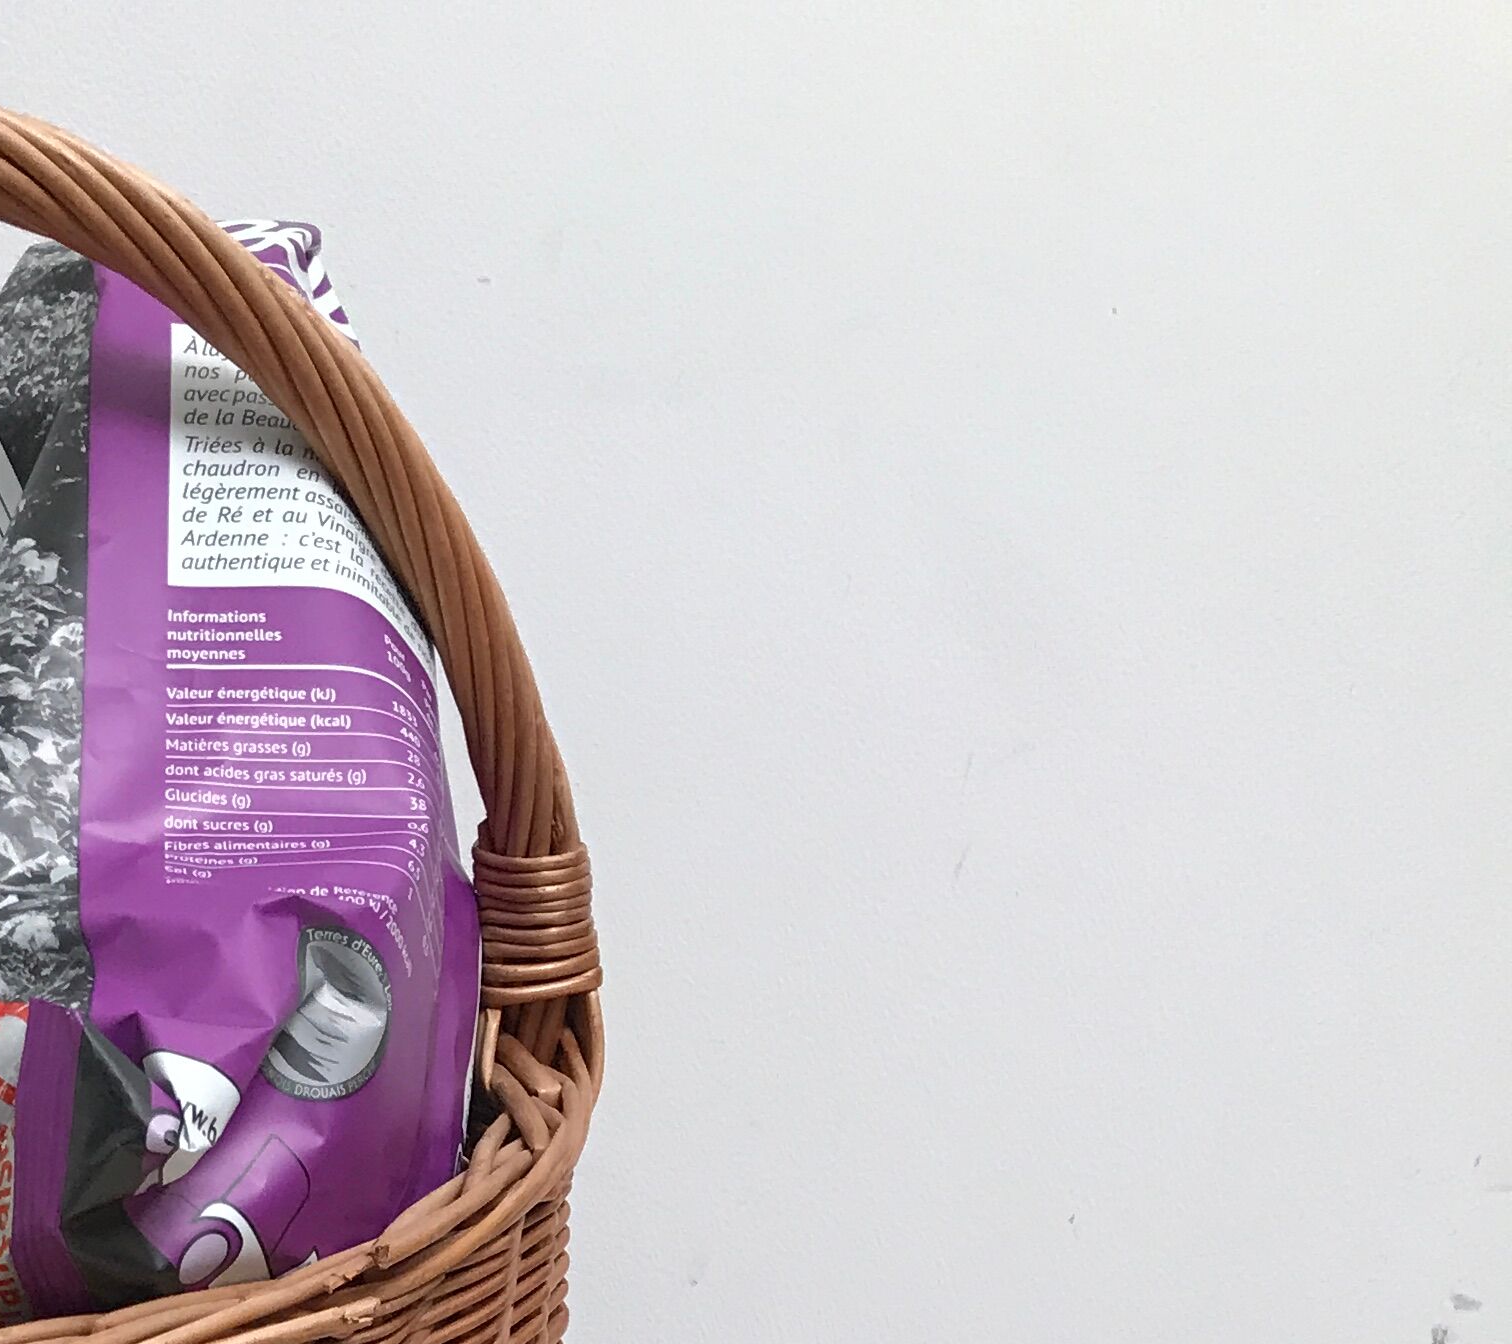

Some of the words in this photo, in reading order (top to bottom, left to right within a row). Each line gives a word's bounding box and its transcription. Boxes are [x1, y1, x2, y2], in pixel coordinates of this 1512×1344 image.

[184, 337, 204, 355] À
[184, 366, 220, 379] nos
[183, 388, 229, 402] avec
[183, 408, 208, 426] de
[215, 408, 234, 426] la
[185, 435, 242, 454] Triées
[252, 436, 264, 453] à
[275, 439, 294, 456] la
[182, 458, 280, 477] chaudron
[295, 466, 320, 483] en
[181, 482, 300, 504] légèrement
[182, 506, 208, 524] de
[216, 506, 242, 523] Ré
[252, 507, 273, 523] et
[282, 510, 307, 524] au
[181, 529, 269, 547] Ardenne
[298, 531, 341, 554] c'est
[349, 549, 365, 569] la
[181, 552, 306, 574] authentique
[310, 556, 331, 572] et
[167, 609, 266, 624] Informations
[167, 629, 283, 642] nutritionnelles
[167, 648, 246, 662] moyennes
[166, 687, 214, 700] Valeur
[217, 686, 307, 702] énergétique
[165, 711, 214, 726] Valeur
[217, 712, 307, 728] énergétique
[310, 714, 351, 729] (kcal)
[165, 738, 229, 752] Matières
[233, 742, 288, 756] grasses
[292, 741, 312, 757] (g)
[165, 763, 199, 777] dont
[203, 766, 250, 781] acides
[254, 770, 286, 783] gras
[290, 768, 343, 783] saturés
[347, 769, 367, 785] (g)
[165, 788, 228, 806] Glucides
[231, 793, 251, 809] (g)
[408, 796, 427, 812] 38
[164, 815, 198, 829] dont
[202, 818, 250, 832] sucres
[253, 819, 274, 834] (g)
[164, 840, 210, 852] Fibres
[306, 926, 349, 945] Terres
[293, 1083, 346, 1099] DROUAIS
